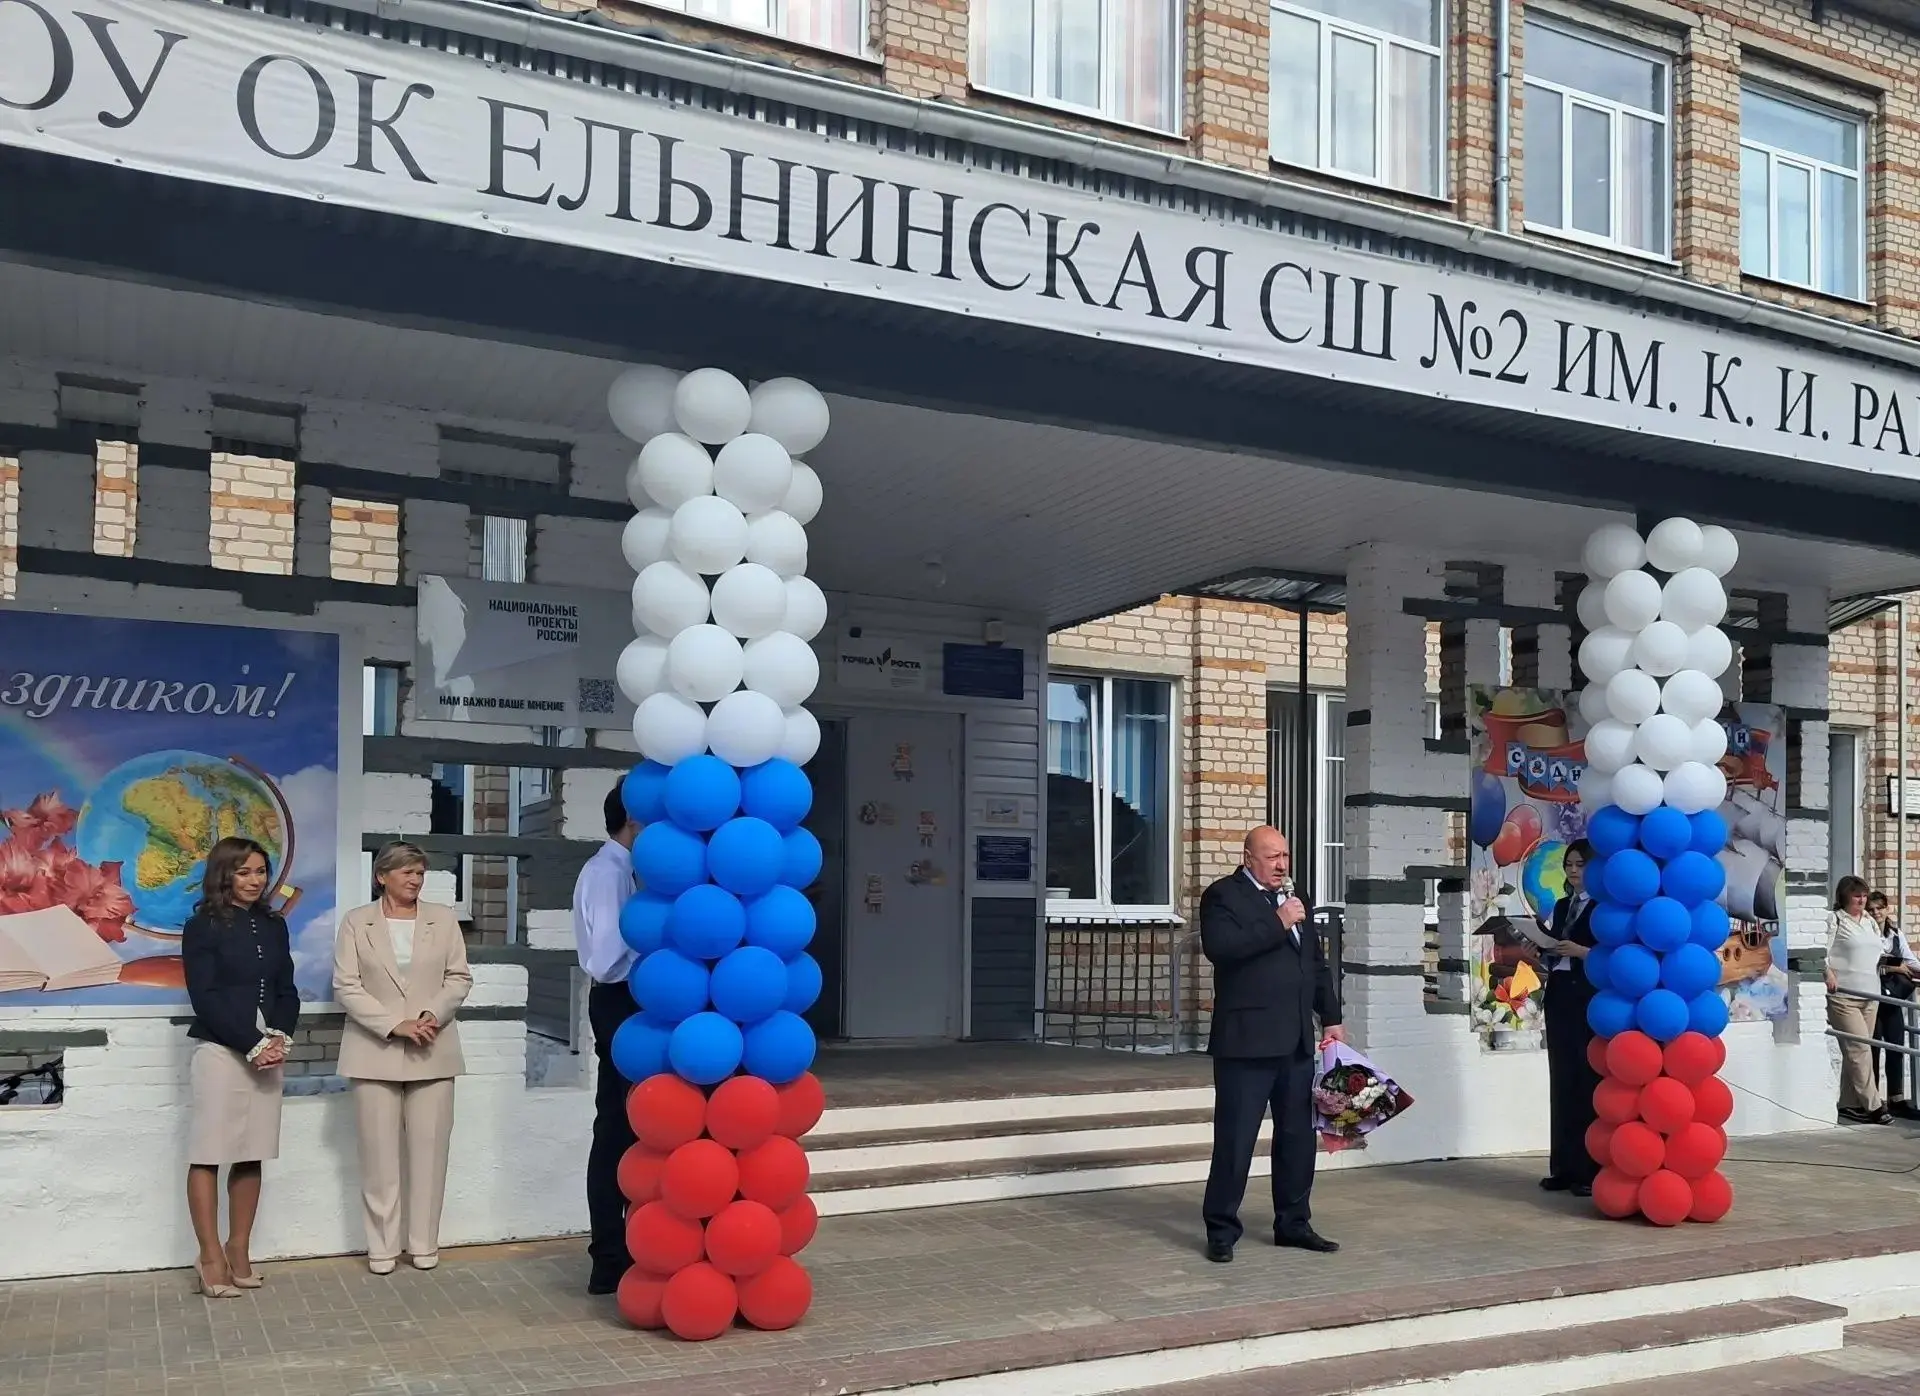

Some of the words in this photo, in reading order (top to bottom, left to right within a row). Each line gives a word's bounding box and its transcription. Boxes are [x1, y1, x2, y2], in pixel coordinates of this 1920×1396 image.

[237, 55, 438, 184] ОК
[477, 97, 1233, 330] ЕЛЬНИНСКАЯ
[1260, 263, 1400, 361] СШ
[1420, 293, 1529, 384] №2
[1552, 320, 1678, 413] ИМ.
[1700, 351, 1753, 427] К.
[1775, 367, 1829, 441] И.
[1848, 383, 1920, 458] РА
[489, 599, 579, 618] НАЦИОНАЛЬНЫЕ
[528, 615, 578, 630] ПРОЕКТЫ
[537, 629, 578, 643] РОССИИ
[891, 659, 921, 670] РОСТА
[439, 695, 460, 707] НАМ
[463, 696, 496, 708] ВАЖНО
[498, 698, 525, 710] ВАШЕ
[528, 700, 565, 712] МНЕНИЕ
